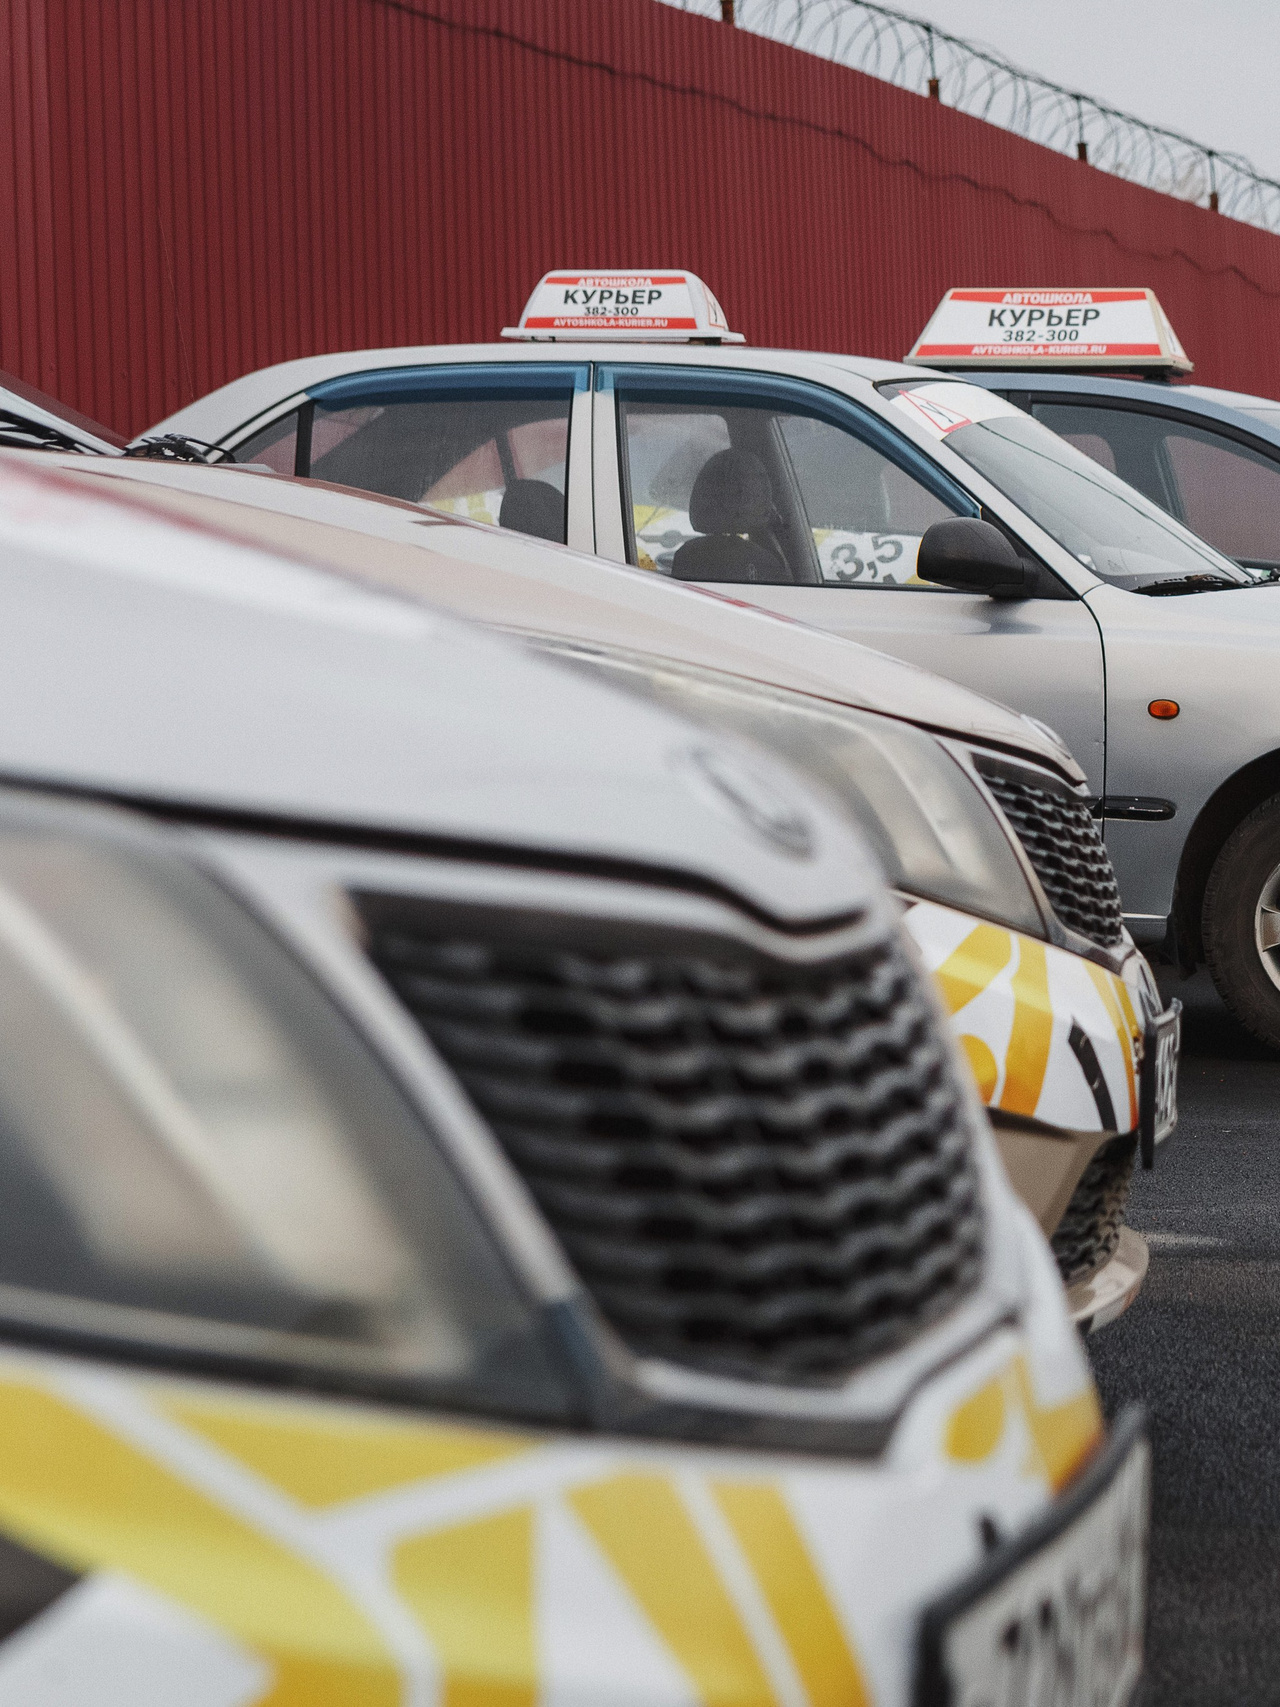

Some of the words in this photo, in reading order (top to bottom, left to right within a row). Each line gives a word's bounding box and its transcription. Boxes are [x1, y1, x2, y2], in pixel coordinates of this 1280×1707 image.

[578, 277, 653, 287] АВТОШКОЛА
[563, 289, 663, 305] КУРЬЕР
[1001, 292, 1093, 304] АВТОШКОЛА
[584, 306, 639, 316] 382-300
[553, 318, 669, 328] AVTOSHKOLA-KURIER.RU
[988, 308, 1101, 327] КУРЬЕР
[1002, 329, 1079, 342] 382-300
[971, 345, 1107, 355] AVTOSHKOLA-KURIER.RU
